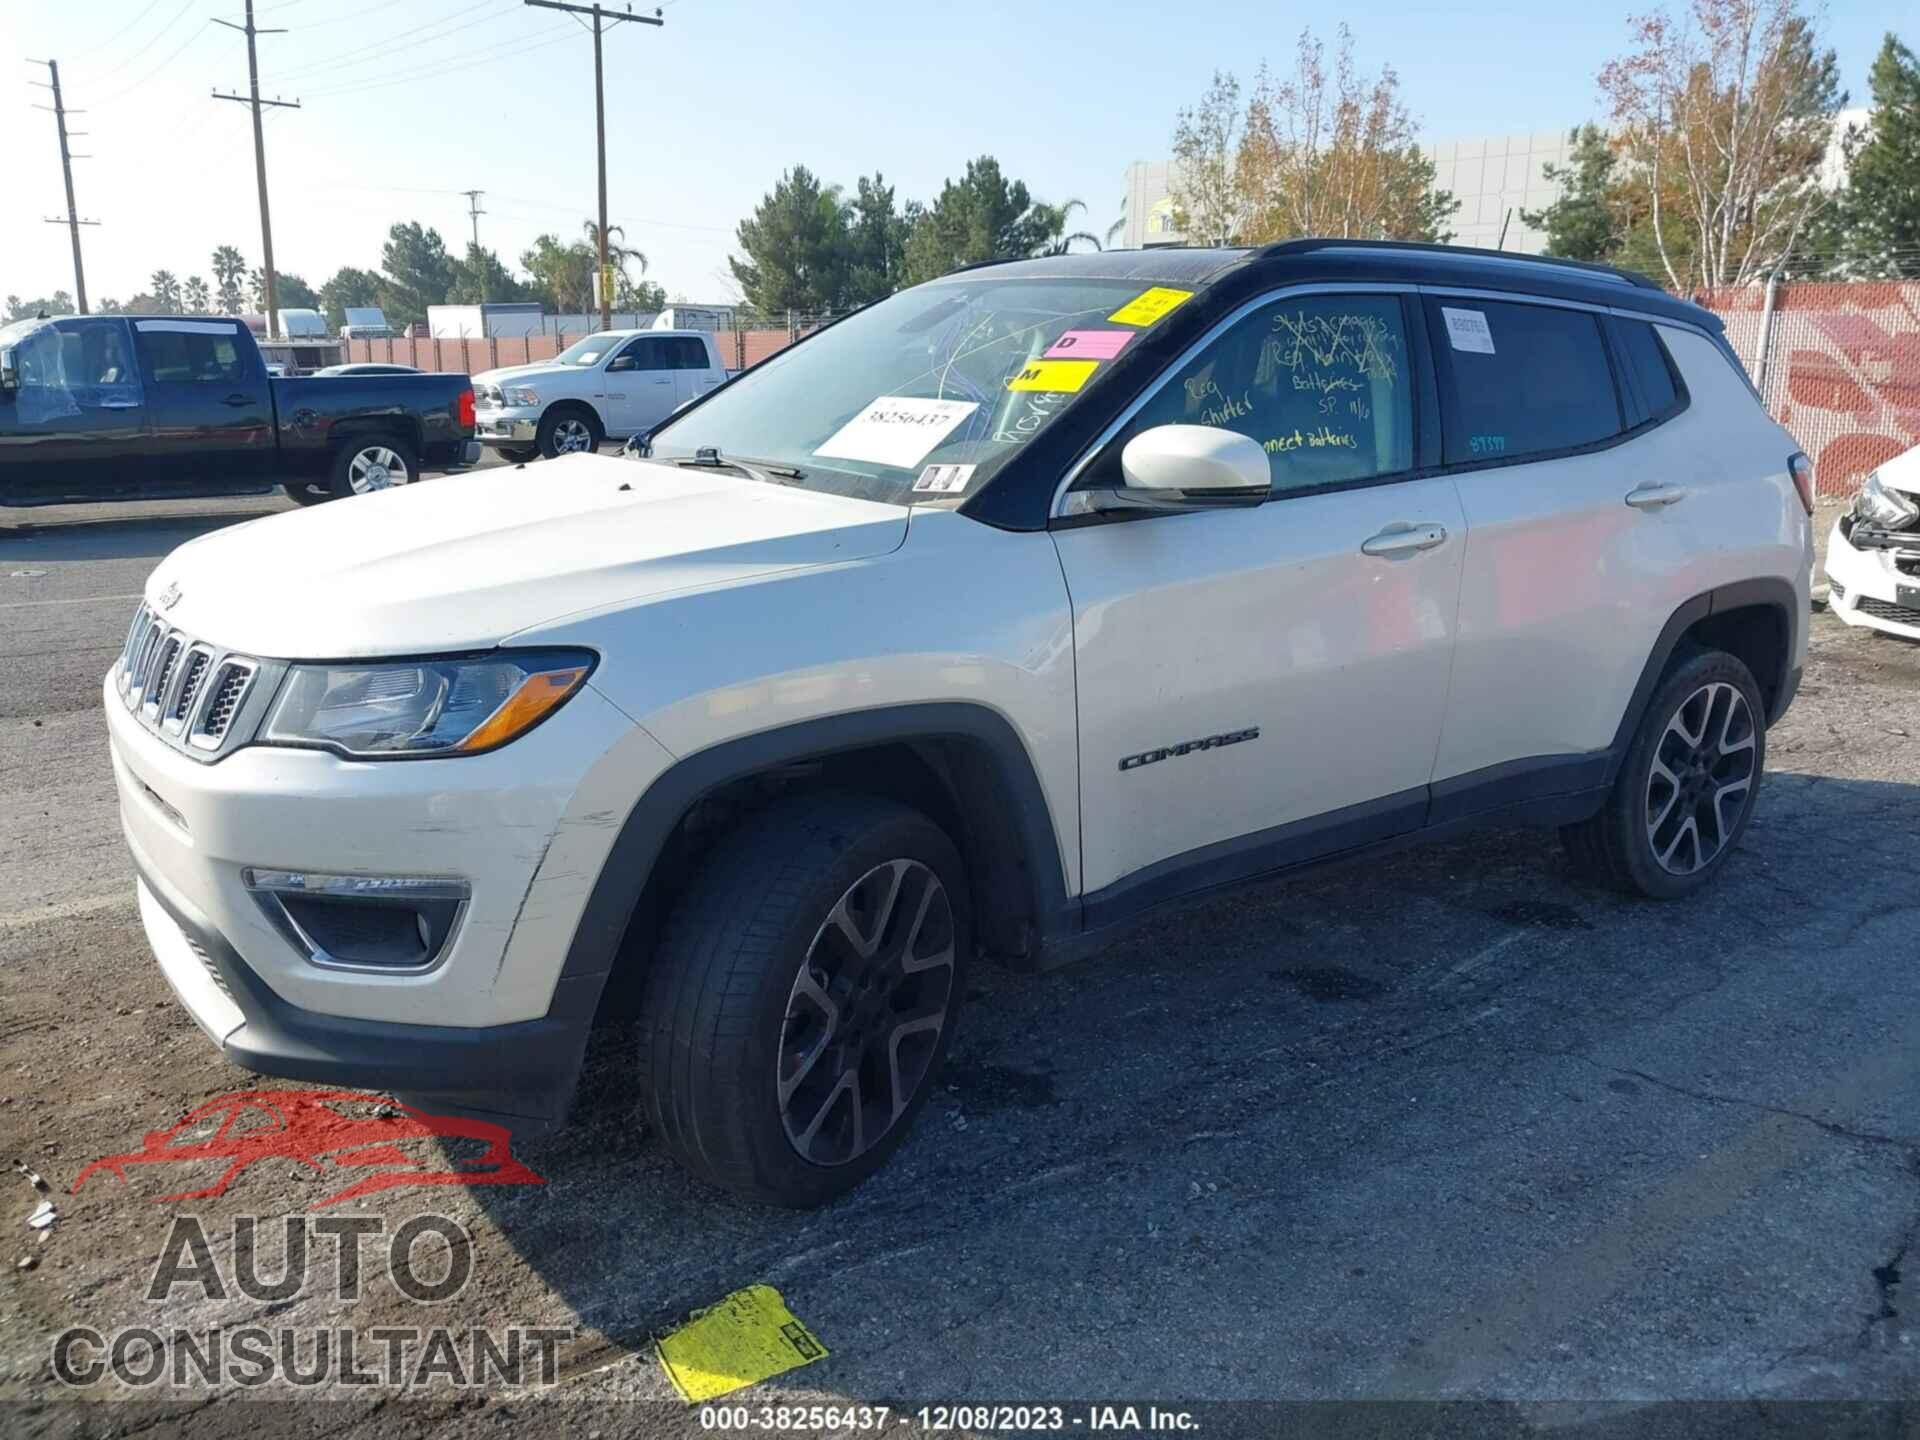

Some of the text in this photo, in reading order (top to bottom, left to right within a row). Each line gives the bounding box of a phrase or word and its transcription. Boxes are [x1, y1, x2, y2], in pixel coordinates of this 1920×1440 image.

[1056, 337, 1077, 349] D
[1020, 369, 1042, 380] M
[1118, 726, 1260, 771] COMPASS
